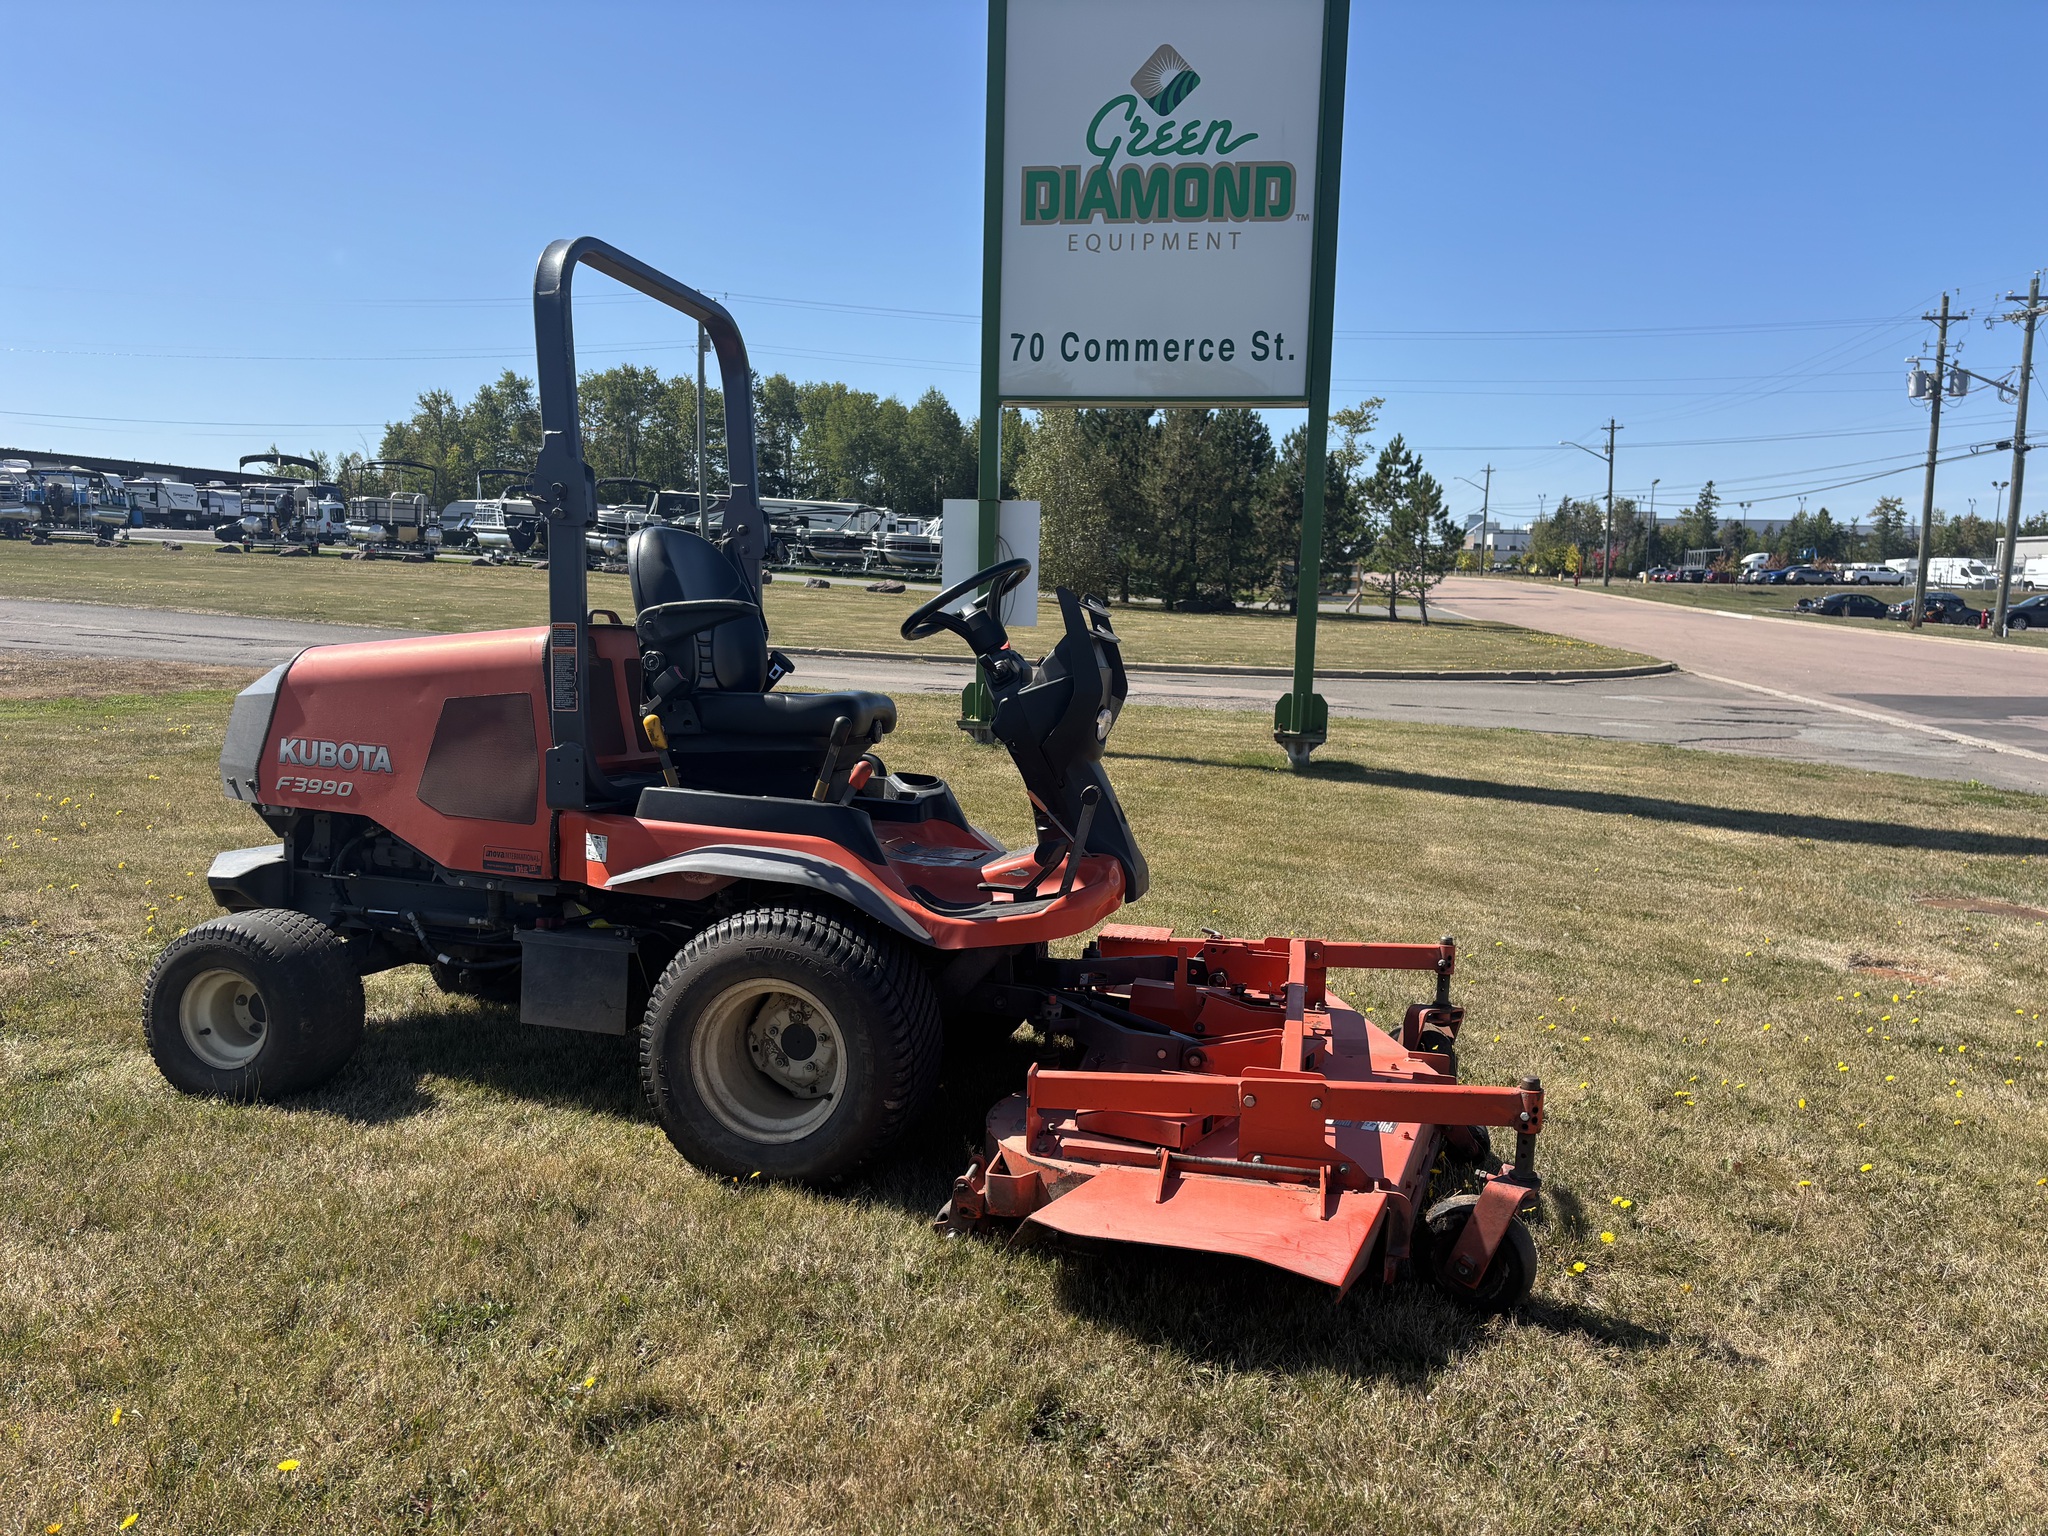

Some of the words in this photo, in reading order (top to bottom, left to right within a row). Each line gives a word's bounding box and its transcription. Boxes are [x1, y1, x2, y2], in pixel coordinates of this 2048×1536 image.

[1086, 94, 1259, 170] Green
[1021, 161, 1296, 225] DIAMOND
[1068, 231, 1242, 253] EQUIPMENT
[1010, 333, 1045, 362] 70
[1060, 331, 1236, 363] Commerce
[1251, 330, 1295, 362] St.
[279, 737, 393, 773] KUBOTA
[275, 776, 354, 797] F3990
